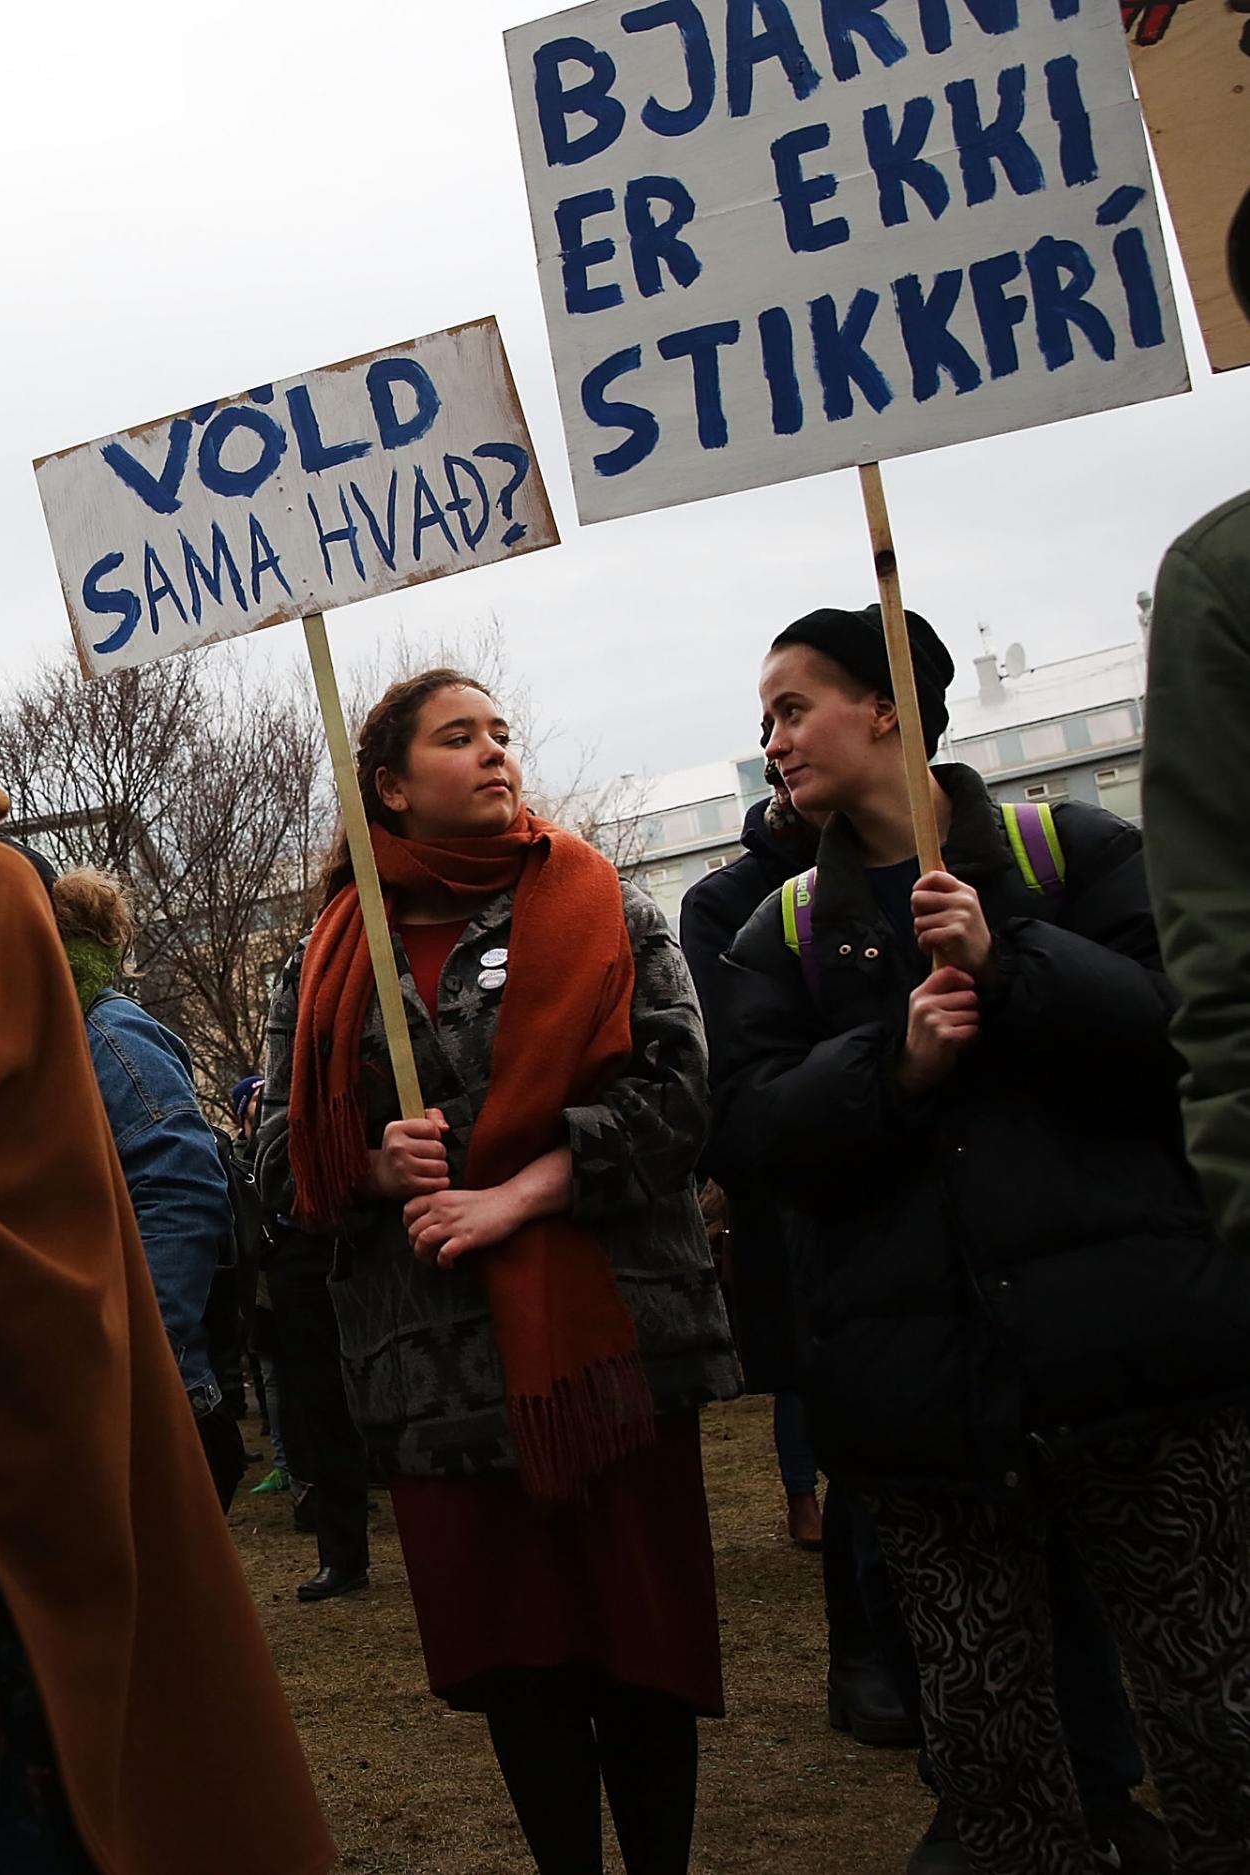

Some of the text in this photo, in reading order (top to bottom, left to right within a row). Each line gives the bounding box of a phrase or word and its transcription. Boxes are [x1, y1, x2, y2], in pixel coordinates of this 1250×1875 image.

[533, 0, 1080, 166] BJAR
[554, 55, 1098, 315] ER EKKI
[100, 357, 440, 514] VÖLD
[581, 185, 1165, 477] STIKKFRÍ
[82, 442, 530, 653] SAMA HVAÐ?
